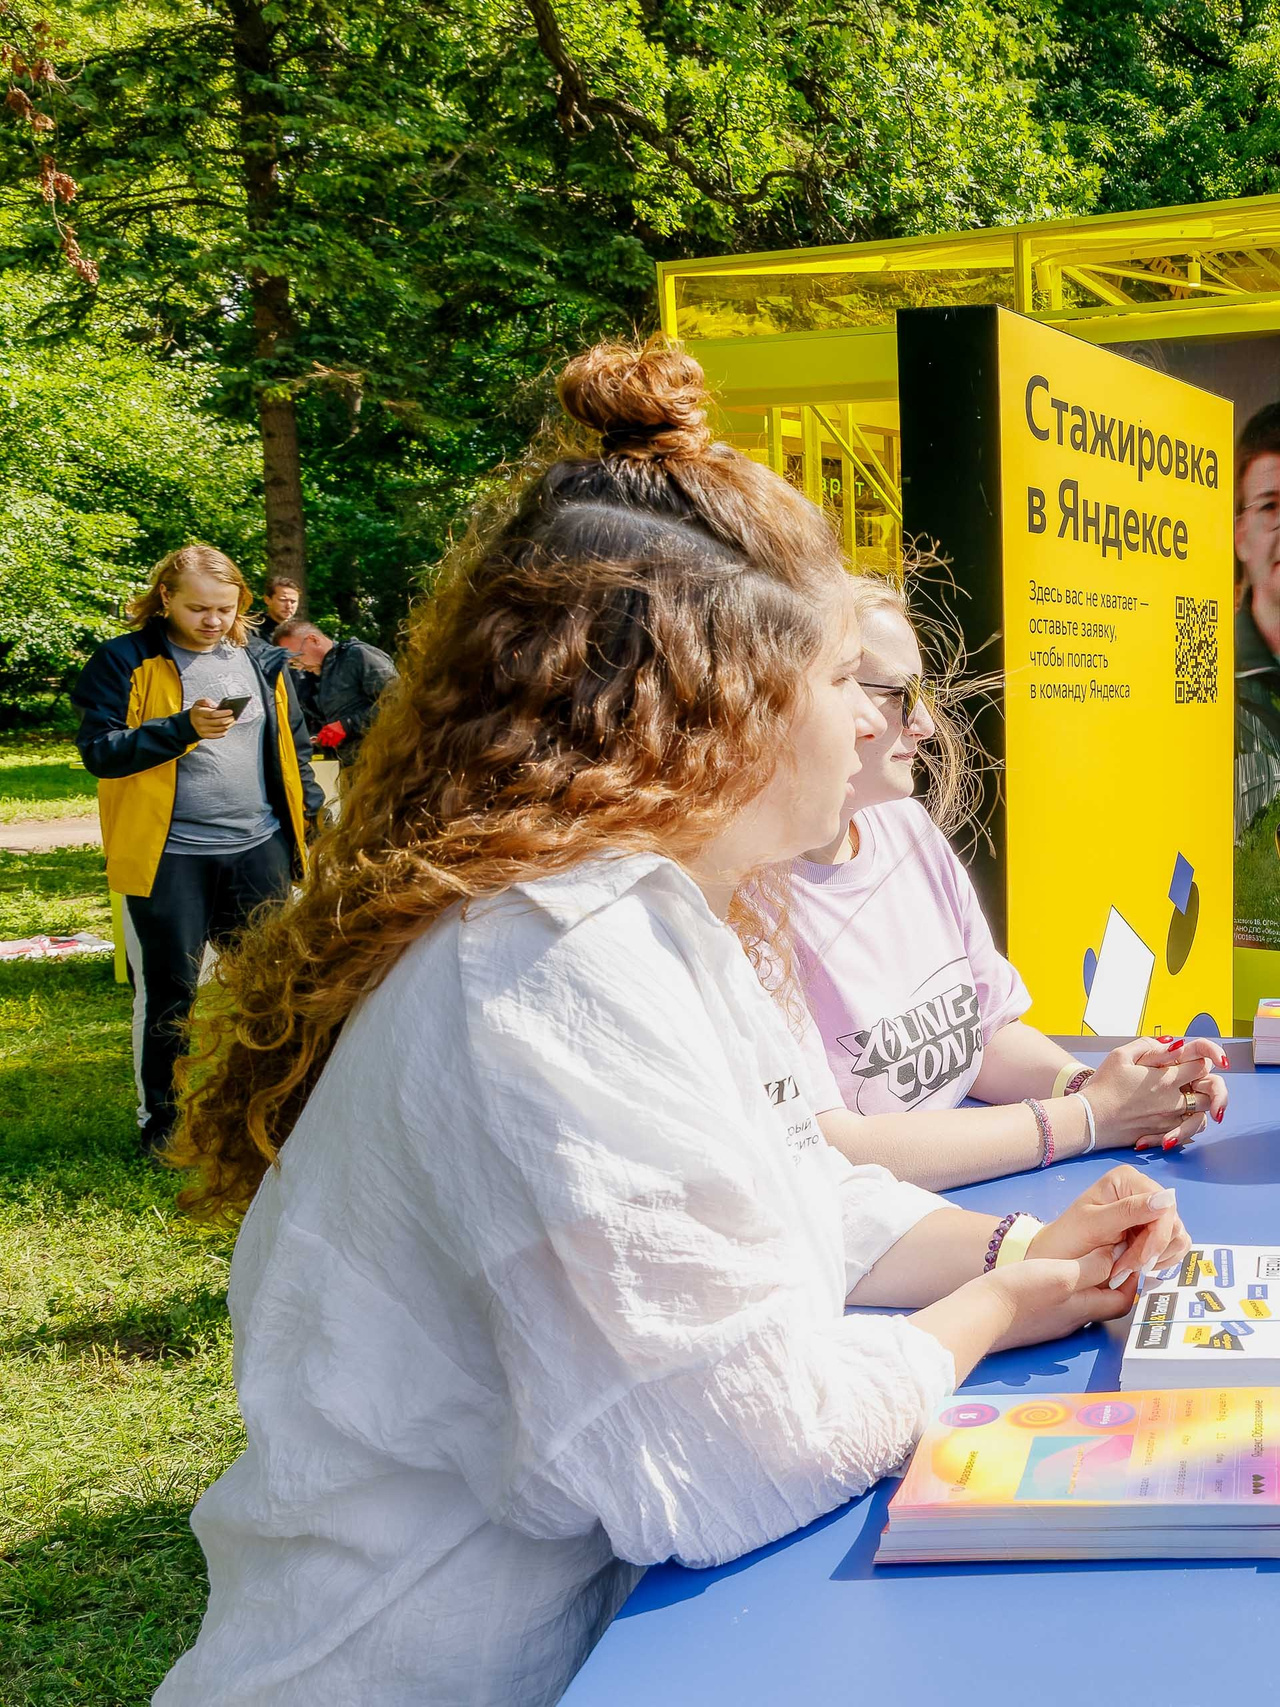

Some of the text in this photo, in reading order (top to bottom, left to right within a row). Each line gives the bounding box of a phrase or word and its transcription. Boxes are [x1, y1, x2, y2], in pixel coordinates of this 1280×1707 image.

[1025, 375, 1219, 490] Стажировка
[1028, 479, 1189, 561] в Яндексе
[1029, 580, 1063, 606] Здесь
[1065, 589, 1084, 606] вас
[1086, 592, 1098, 607] не
[1100, 593, 1138, 611] хватает
[1029, 618, 1117, 643] оставьте заявку,
[1029, 646, 1109, 669] чтобы попасть
[1030, 679, 1131, 703] в команду Яндекса
[958, 1412, 978, 1420] Я
[1251, 1399, 1264, 1458] Яндекс Образование
